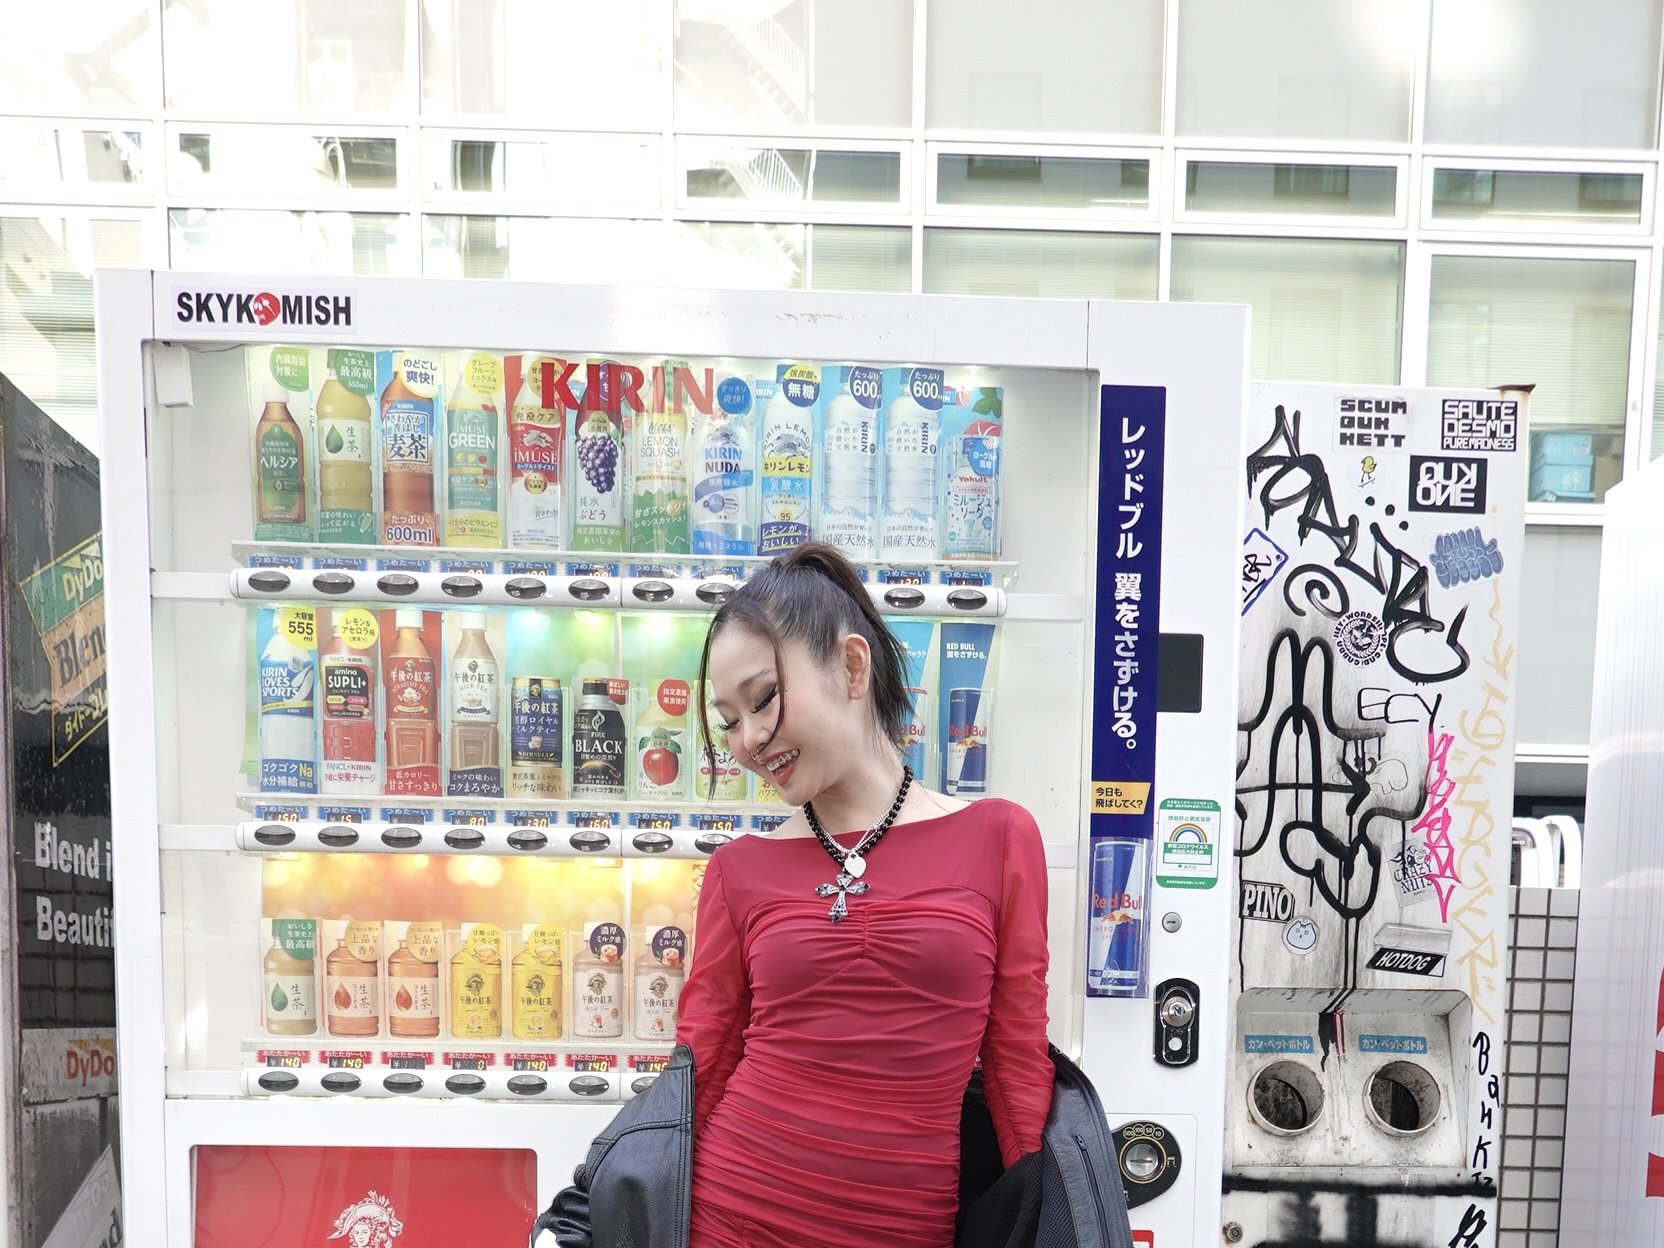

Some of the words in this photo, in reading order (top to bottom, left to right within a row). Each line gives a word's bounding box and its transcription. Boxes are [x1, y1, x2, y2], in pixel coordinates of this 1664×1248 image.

[404, 359, 437, 371] のどごし
[341, 366, 372, 379] 最高級
[854, 370, 879, 380] たっぷり
[914, 371, 940, 381] たっぷり
[541, 362, 714, 414] KIRIN
[788, 382, 815, 400] 無糖
[1340, 399, 1407, 415] SCUM
[1444, 401, 1515, 421] SAUTE
[516, 412, 555, 422] 免疫ケア
[1443, 419, 1515, 438] DESMO
[347, 426, 358, 457] 生茶
[449, 432, 496, 450] GREEN
[642, 436, 678, 447] LEMON
[861, 421, 869, 453] KIRIN
[921, 422, 929, 454] KIRIN
[1339, 432, 1406, 447] KETT
[388, 434, 426, 459] 麦茶
[640, 447, 680, 458] SQUASH
[705, 447, 742, 460] KIRIN
[261, 456, 298, 469] ヘルシア
[705, 461, 741, 474] NUDA
[1115, 417, 1146, 559] レッドブル
[392, 515, 425, 524] たっぷり
[579, 510, 606, 520] ぶどう
[960, 507, 984, 519] ソーダ
[387, 527, 432, 542] 600ml
[822, 533, 875, 548] 国産天然水
[762, 537, 799, 549] おいしい
[883, 535, 936, 549] 国産天然水
[62, 559, 103, 602] DyDo
[294, 612, 314, 620] 大容量
[288, 621, 314, 635] 555
[342, 627, 375, 636] アセロラ味
[960, 643, 975, 651] BULL
[1111, 572, 1143, 750] 翼をさずける。
[390, 668, 432, 682] 午後の紅茶
[453, 672, 495, 685] 午後の紅茶
[328, 676, 367, 688] SUPLI+
[262, 687, 299, 698] SPORTS
[514, 701, 559, 715] 午後の紅茶
[516, 726, 557, 735] ミルクティー
[575, 740, 623, 754] BLACK
[263, 763, 298, 773] ゴクゴク
[299, 763, 313, 778] Na
[389, 780, 438, 792] 甘さすっきり
[449, 782, 500, 793] コクまろやか
[512, 782, 561, 793] リッチな味わい
[1095, 787, 1123, 797] 今日も
[1095, 798, 1143, 810] 飛ばしてく?
[34, 821, 99, 881] Blend
[1393, 861, 1432, 882] CRAZY
[1093, 893, 1118, 909] Red
[1120, 893, 1143, 910] Bul
[1243, 884, 1293, 921] PINO
[600, 926, 617, 935] 濃厚
[662, 930, 679, 938] 濃厚
[285, 939, 316, 950] 最高級
[358, 946, 375, 955] 香り
[418, 947, 436, 956] 香り
[1375, 952, 1432, 971] HOTDOG
[291, 984, 304, 1010] 生茶
[358, 984, 371, 1010] 生茶
[419, 984, 431, 1010] 生茶
[460, 996, 492, 1005] 午後の紅茶
[521, 997, 552, 1006] 午後の紅茶
[582, 995, 613, 1004] 午後の紅茶
[644, 999, 674, 1008] 午後の紅茶
[66, 1050, 114, 1087] DyDo
[279, 1059, 301, 1067] 140
[341, 1060, 362, 1068] 140
[526, 1061, 546, 1070] 140
[588, 1062, 608, 1071] 140
[1124, 1129, 1134, 1137] 500
[1135, 1126, 1144, 1134] 100
[1145, 1126, 1154, 1134] 50
[1155, 1130, 1162, 1138] 10
